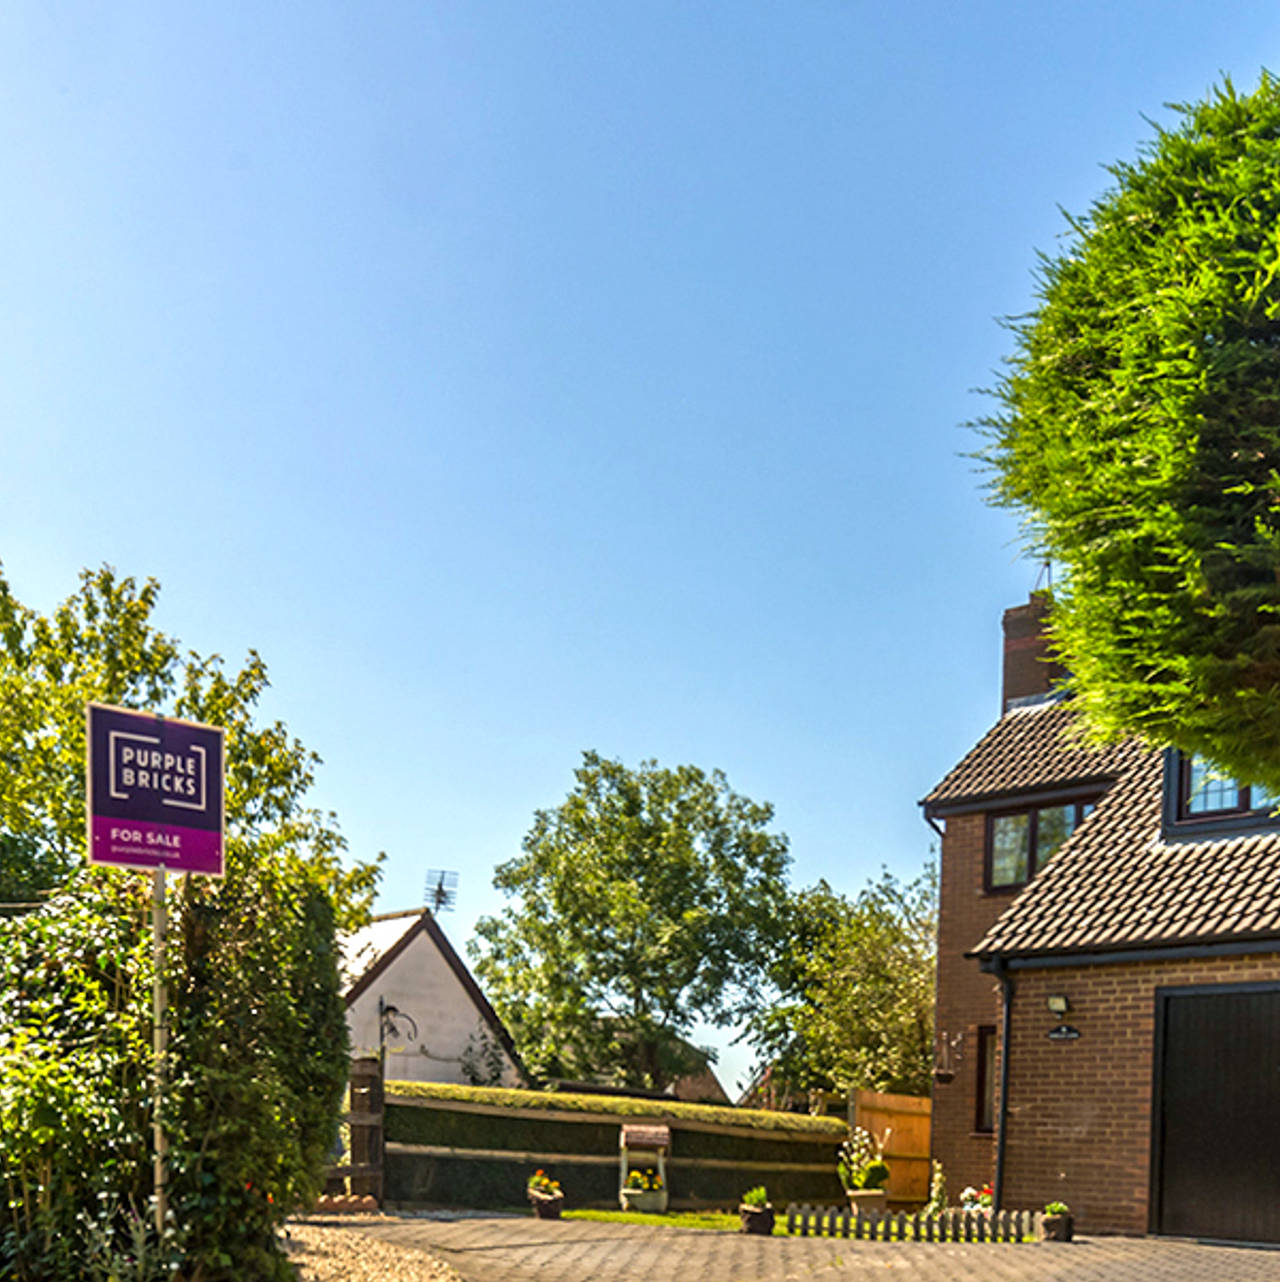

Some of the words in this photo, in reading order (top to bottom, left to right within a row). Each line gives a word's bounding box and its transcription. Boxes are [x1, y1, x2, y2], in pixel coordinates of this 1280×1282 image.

[122, 747, 196, 776] PURPLE
[122, 768, 196, 796] BRICKS
[111, 828, 142, 843] FOR
[146, 832, 181, 848] SALE
